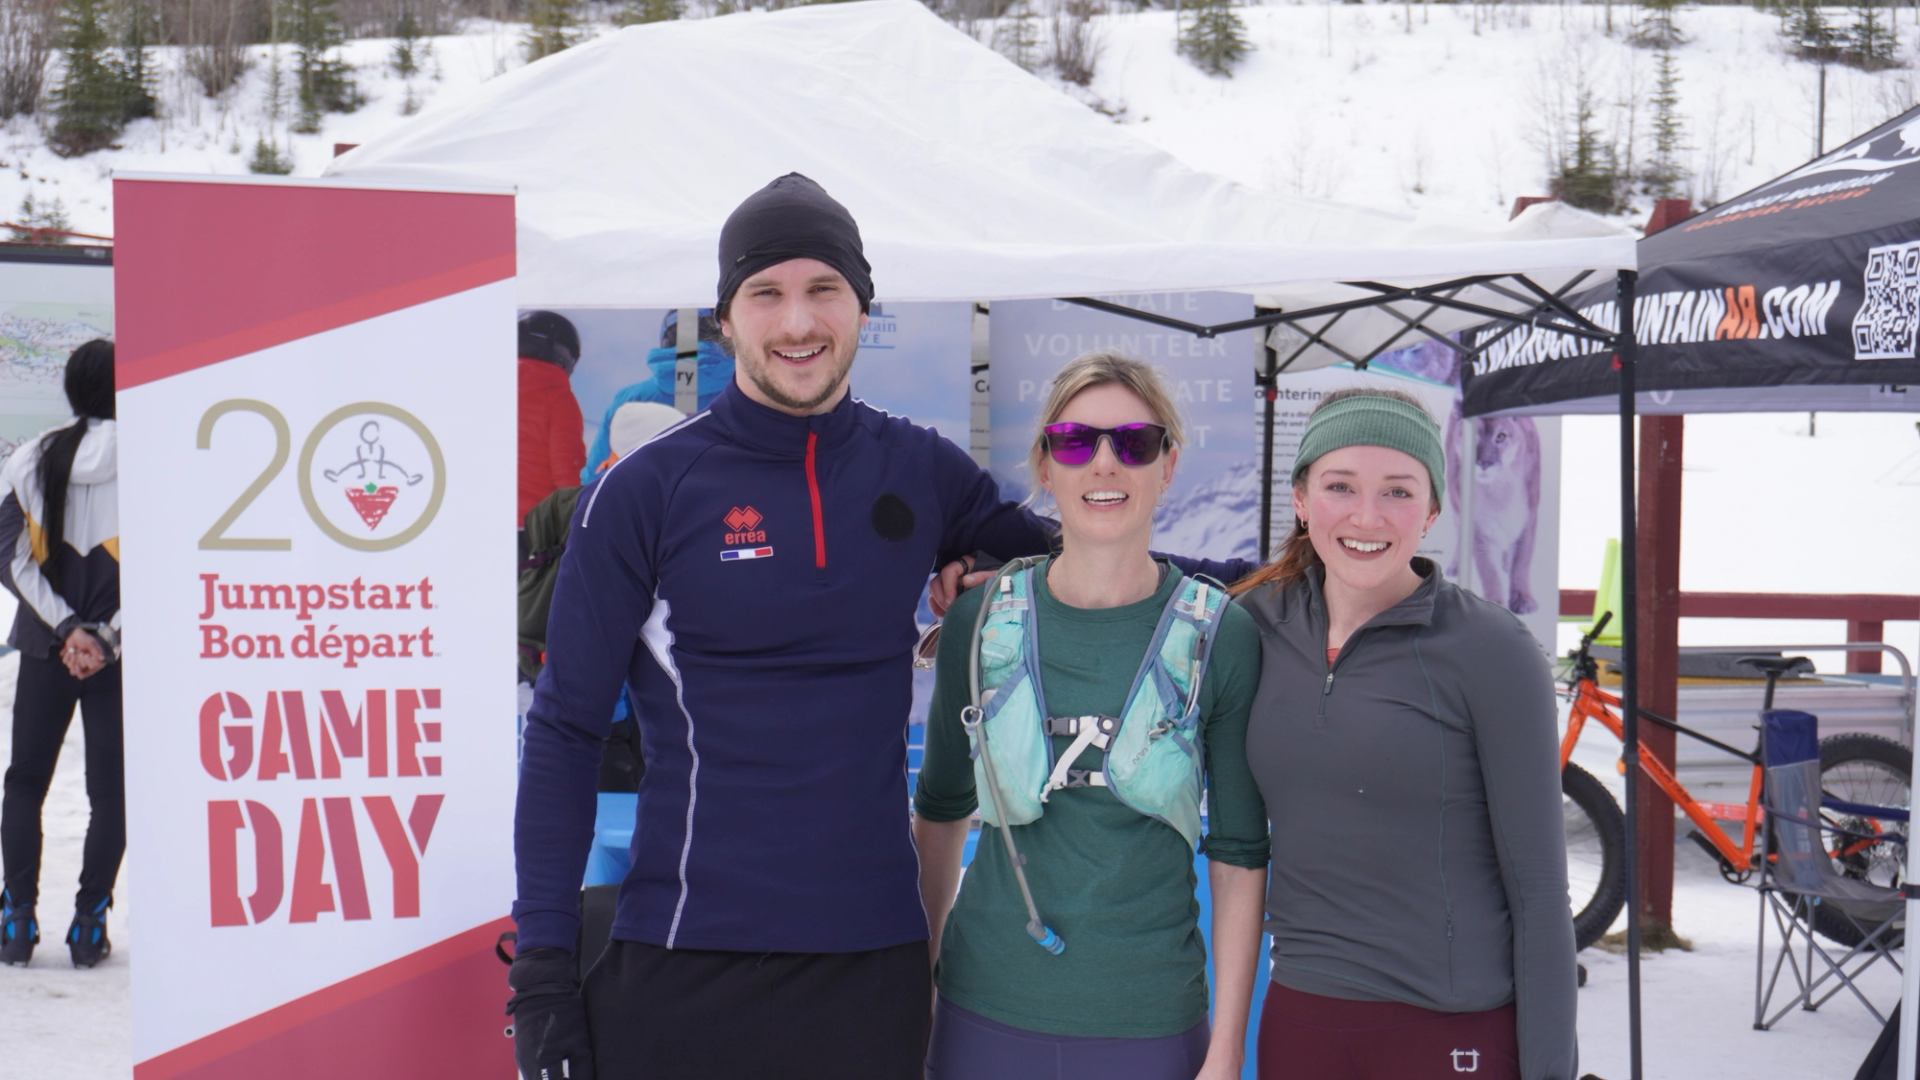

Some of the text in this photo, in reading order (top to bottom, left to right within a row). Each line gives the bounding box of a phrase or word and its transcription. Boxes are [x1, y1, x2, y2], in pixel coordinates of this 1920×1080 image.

[1023, 332, 1227, 358] VOLUNTEER
[724, 530, 767, 545] errea
[198, 573, 434, 621] Jumpstart
[198, 624, 435, 669] Bon départ
[198, 688, 443, 782] GAME
[207, 793, 446, 928] DAY
